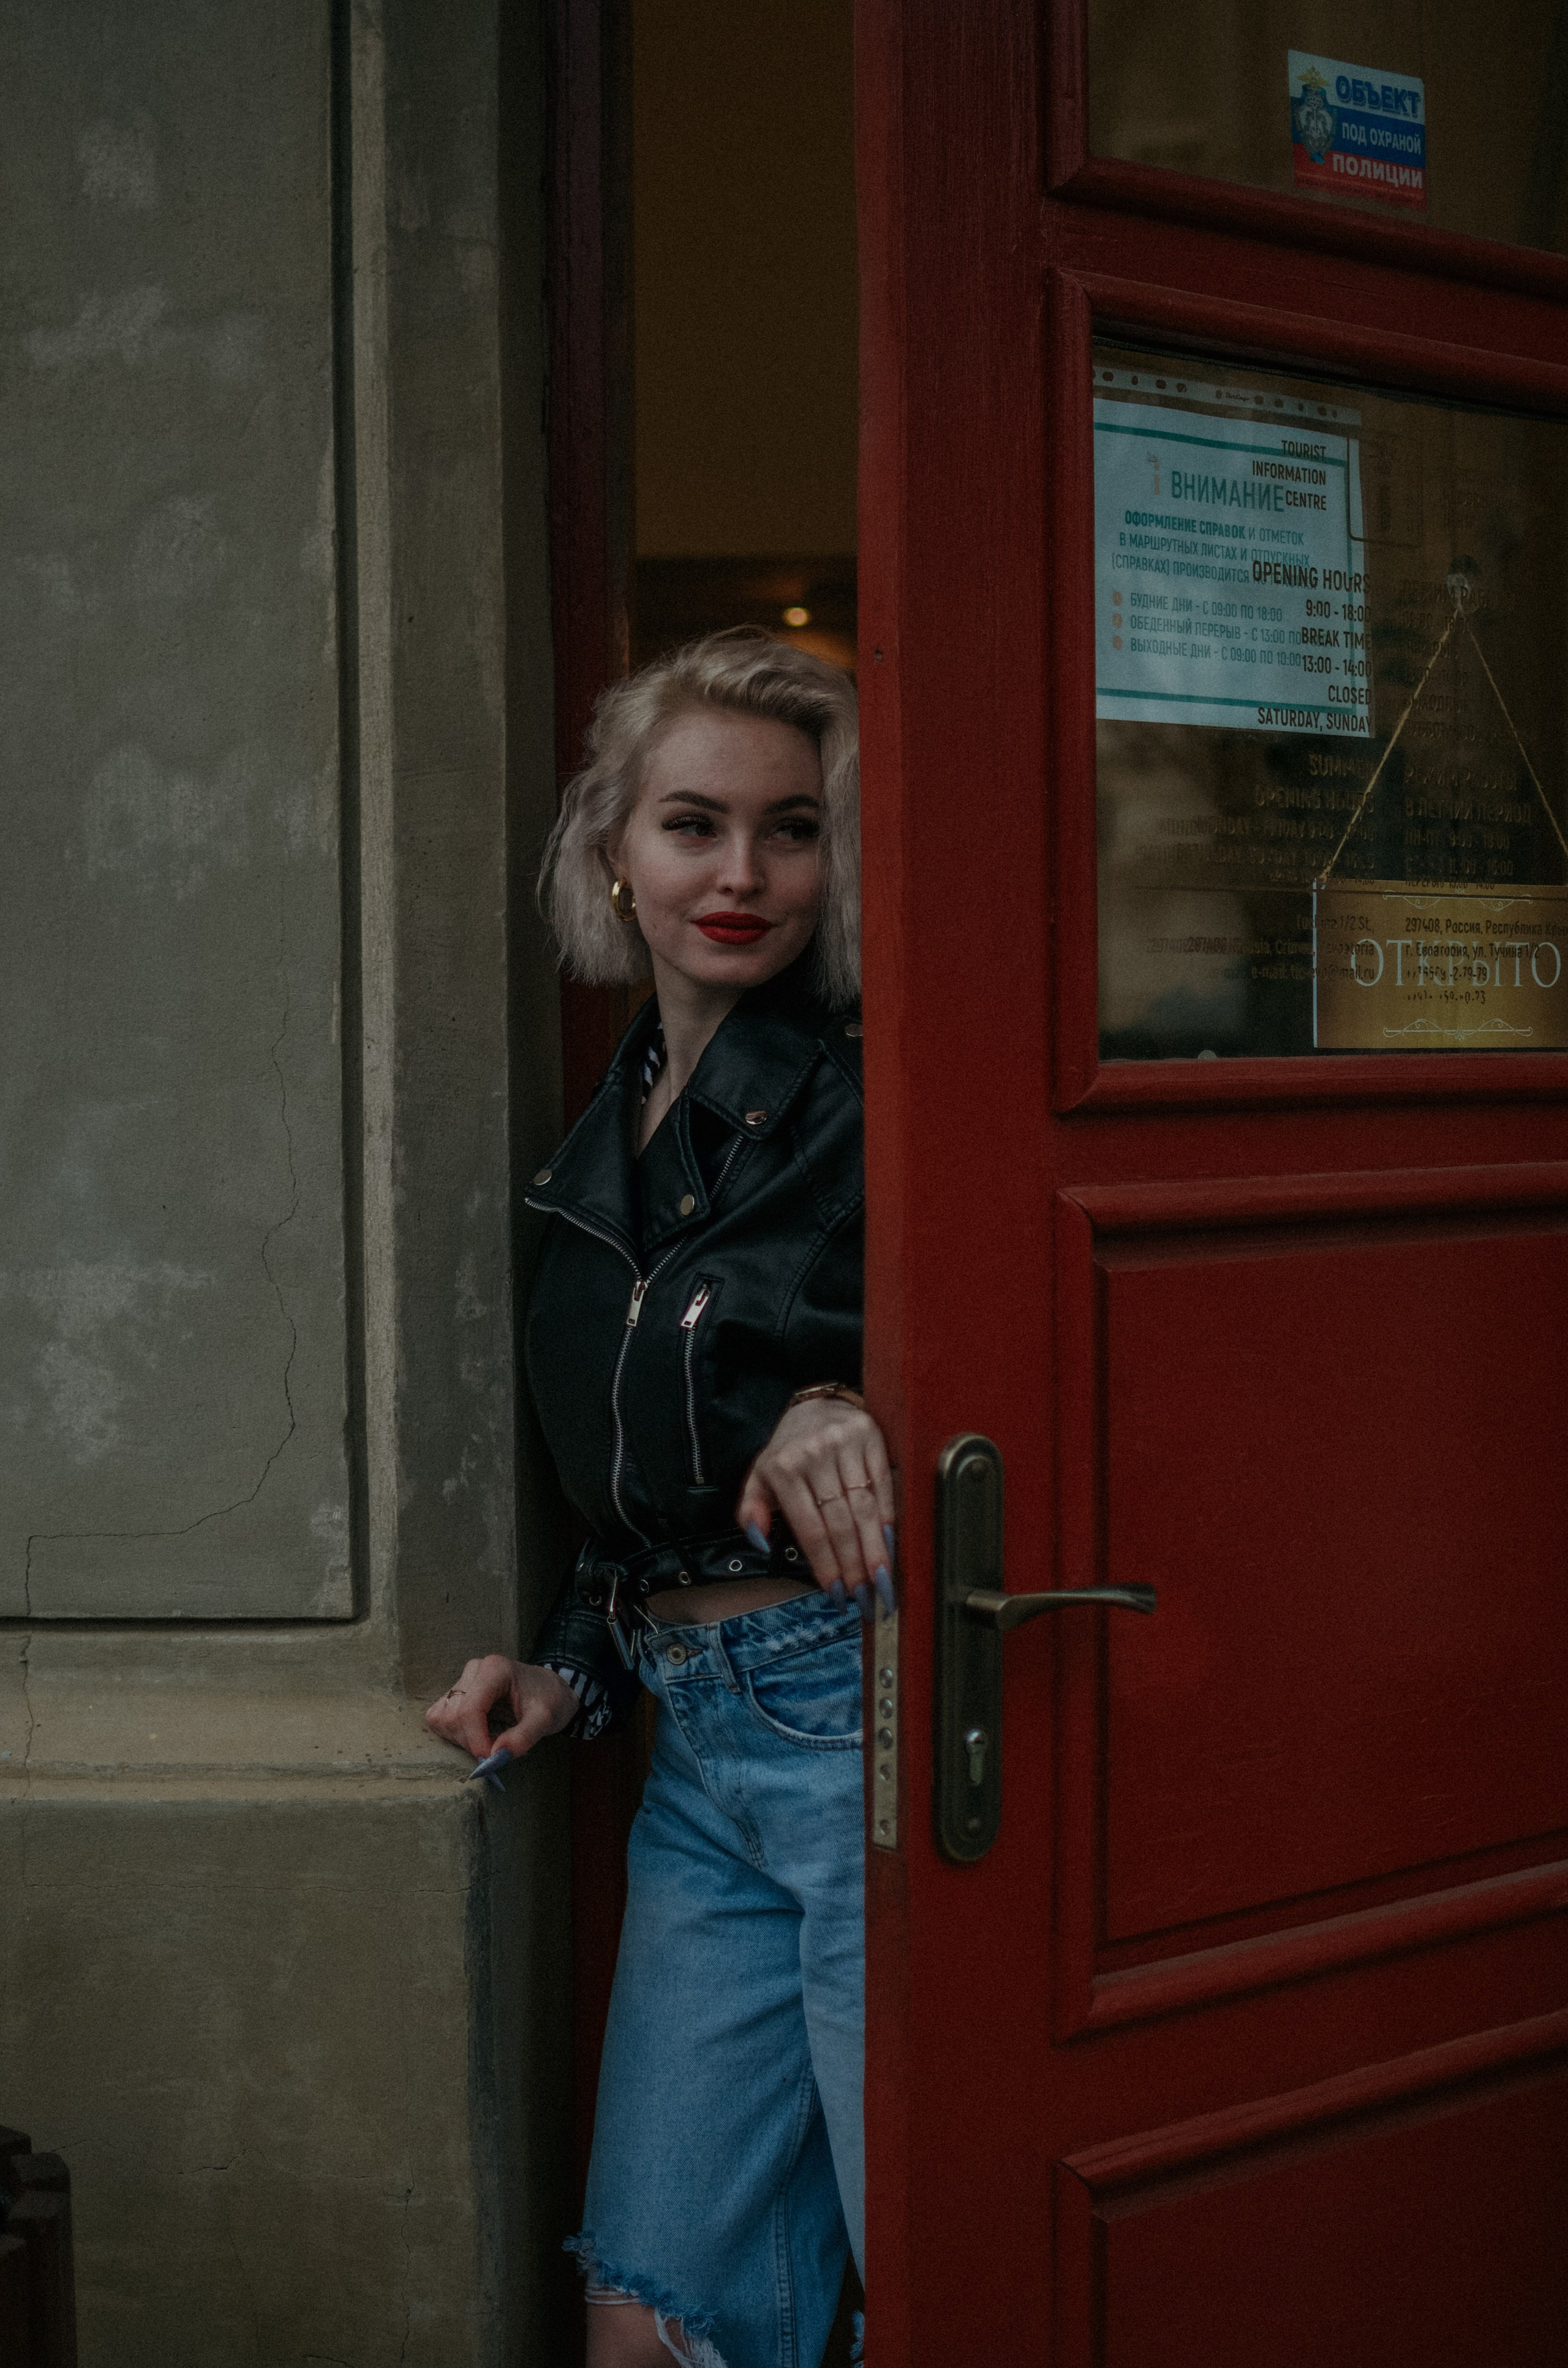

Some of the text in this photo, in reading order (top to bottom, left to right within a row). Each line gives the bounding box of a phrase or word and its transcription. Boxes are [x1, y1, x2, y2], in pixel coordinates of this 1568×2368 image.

[1336, 74, 1420, 118] ОБЪЕКТ
[1342, 122, 1422, 154] ПОД ОХРАНОЙ
[1333, 154, 1423, 189] ПОЛИЦИИ
[1281, 439, 1326, 460] TOURIST
[1252, 460, 1326, 485] INFORMATION
[1171, 471, 1284, 512] ВНИМАНИЕ
[1285, 490, 1327, 510] CENTRE
[1125, 510, 1304, 546] ОФОРМЛЕНИЕ СПРАВОК И ОТМЕТОК
[1120, 532, 1310, 568] В МАРШРУТНЫХ ЛИСТАХ И ОТПУСКНЫХ
[1173, 565, 1249, 585] ПРОИЗВОДИТСЯ
[1252, 560, 1318, 589] OPENING
[1323, 571, 1371, 594] HOURS
[1130, 592, 1169, 610] БУДНИЕ
[1172, 597, 1193, 614] ДНИ
[1203, 600, 1208, 614] С
[1212, 601, 1237, 617] 09:00
[1240, 605, 1254, 619] ПО
[1257, 606, 1283, 622] 18:00
[1305, 600, 1331, 619] 9:00
[1342, 603, 1371, 624] 18:00
[1131, 613, 1192, 635] ОБЕДЕННЫЙ
[1194, 619, 1241, 640] ПЕРЕРЫВ
[1252, 627, 1258, 641] С
[1261, 627, 1285, 644] 13:00
[1289, 631, 1302, 645] ПО
[1302, 627, 1372, 650] BREAK TIME
[1130, 637, 1188, 657] ВЫХОДНЫЕ
[1190, 642, 1211, 660] ДНИ
[1221, 646, 1227, 660] С
[1231, 646, 1257, 663] 09:00
[1260, 649, 1273, 664] ПО
[1276, 651, 1302, 667] 10:00
[1302, 655, 1332, 674] 13:00
[1343, 659, 1372, 678] 14:00
[1328, 684, 1372, 706] CLOSED
[1257, 706, 1373, 733] SATURDAY, SUNDAY
[1405, 917, 1443, 936] 297408,
[1485, 920, 1542, 938] Республика
[1351, 937, 1561, 988] ОТКРЫТО
